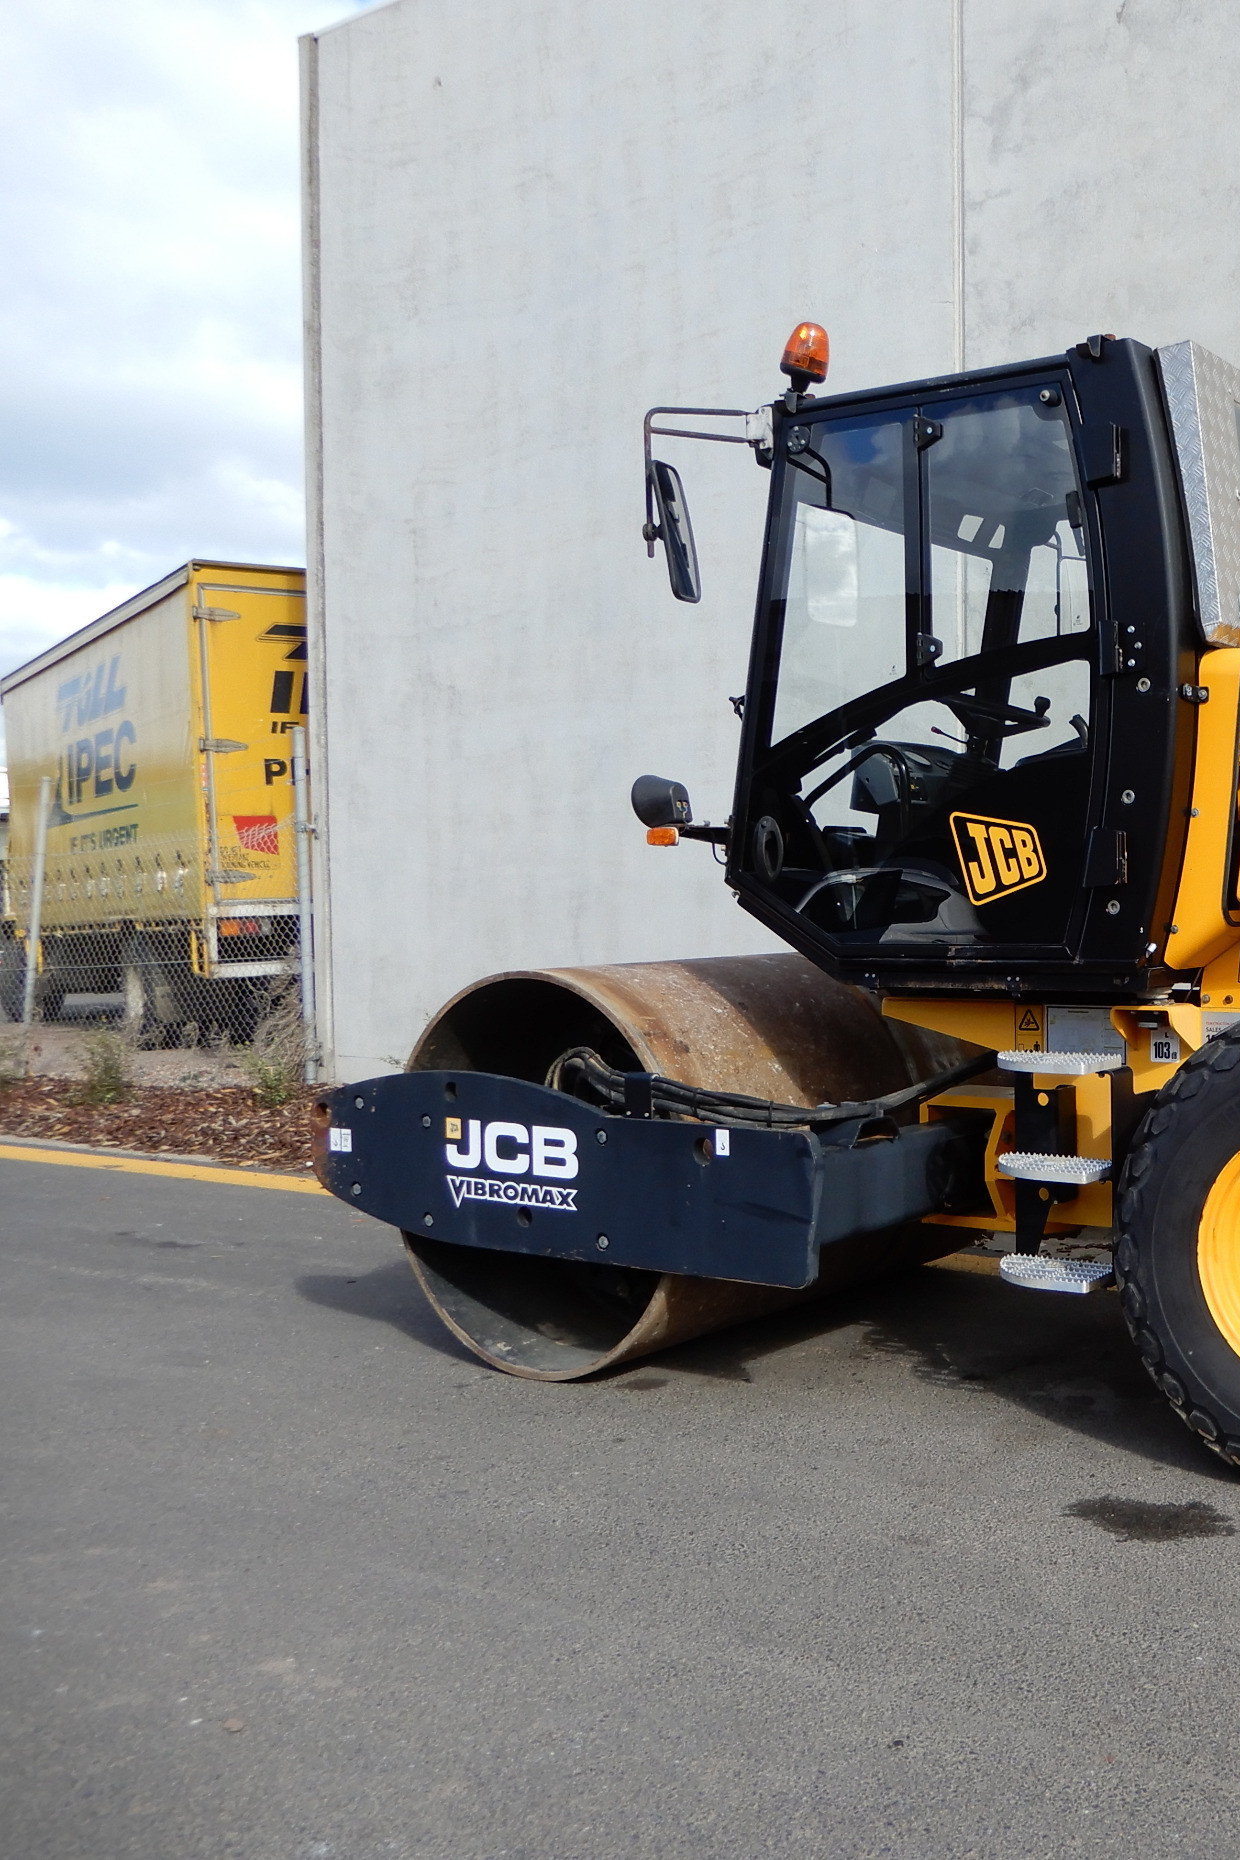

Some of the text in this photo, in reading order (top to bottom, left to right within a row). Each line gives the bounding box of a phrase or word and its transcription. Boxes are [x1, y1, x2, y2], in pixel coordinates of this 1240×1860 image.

[68, 720, 137, 805] IPEC
[966, 822, 1040, 894] JCB
[1153, 1041, 1171, 1059] 103
[446, 1118, 579, 1180] JCB
[446, 1174, 579, 1212] VIBROMAX
